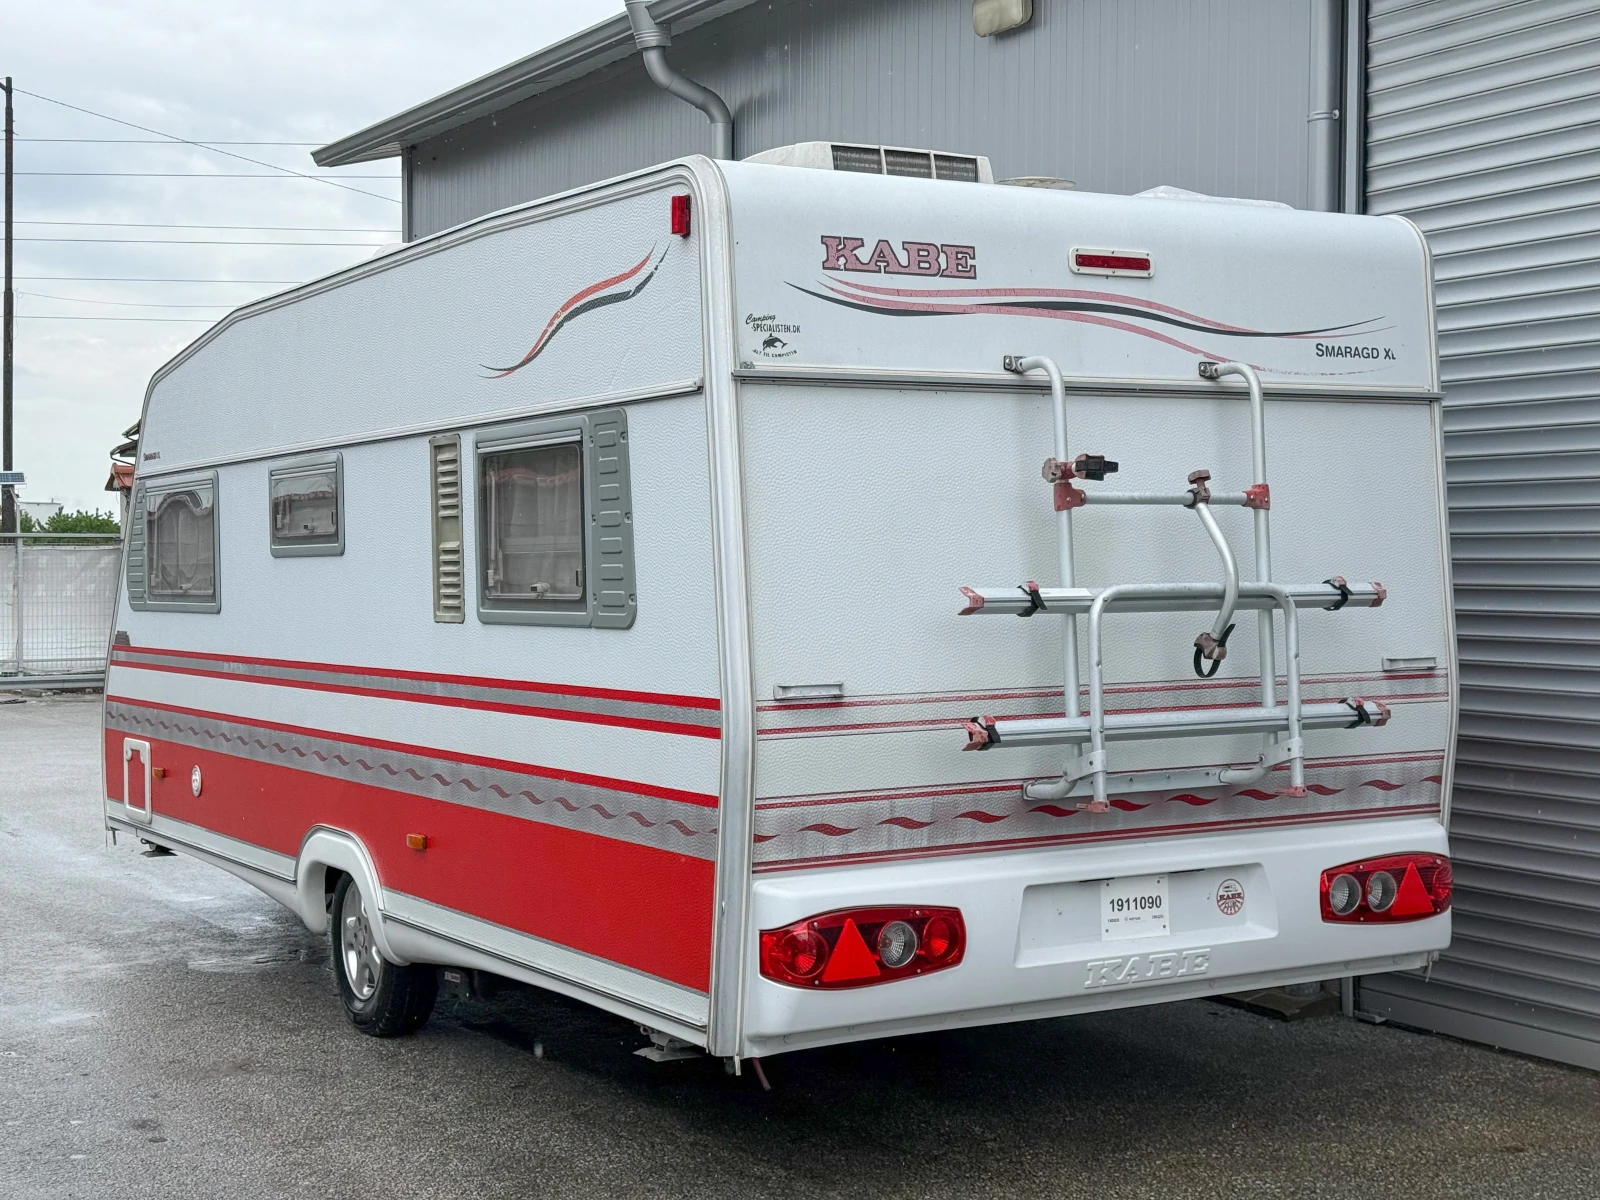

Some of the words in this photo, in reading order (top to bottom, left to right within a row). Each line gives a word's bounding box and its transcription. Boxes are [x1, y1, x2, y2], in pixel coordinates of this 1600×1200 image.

[821, 235, 977, 280] KABE
[745, 313, 776, 325] Camping
[1315, 342, 1380, 360] SMARAGD
[1383, 347, 1397, 360] XL
[1109, 895, 1162, 912] 1911090
[1219, 892, 1242, 901] KABE
[1084, 948, 1211, 989] KABE
